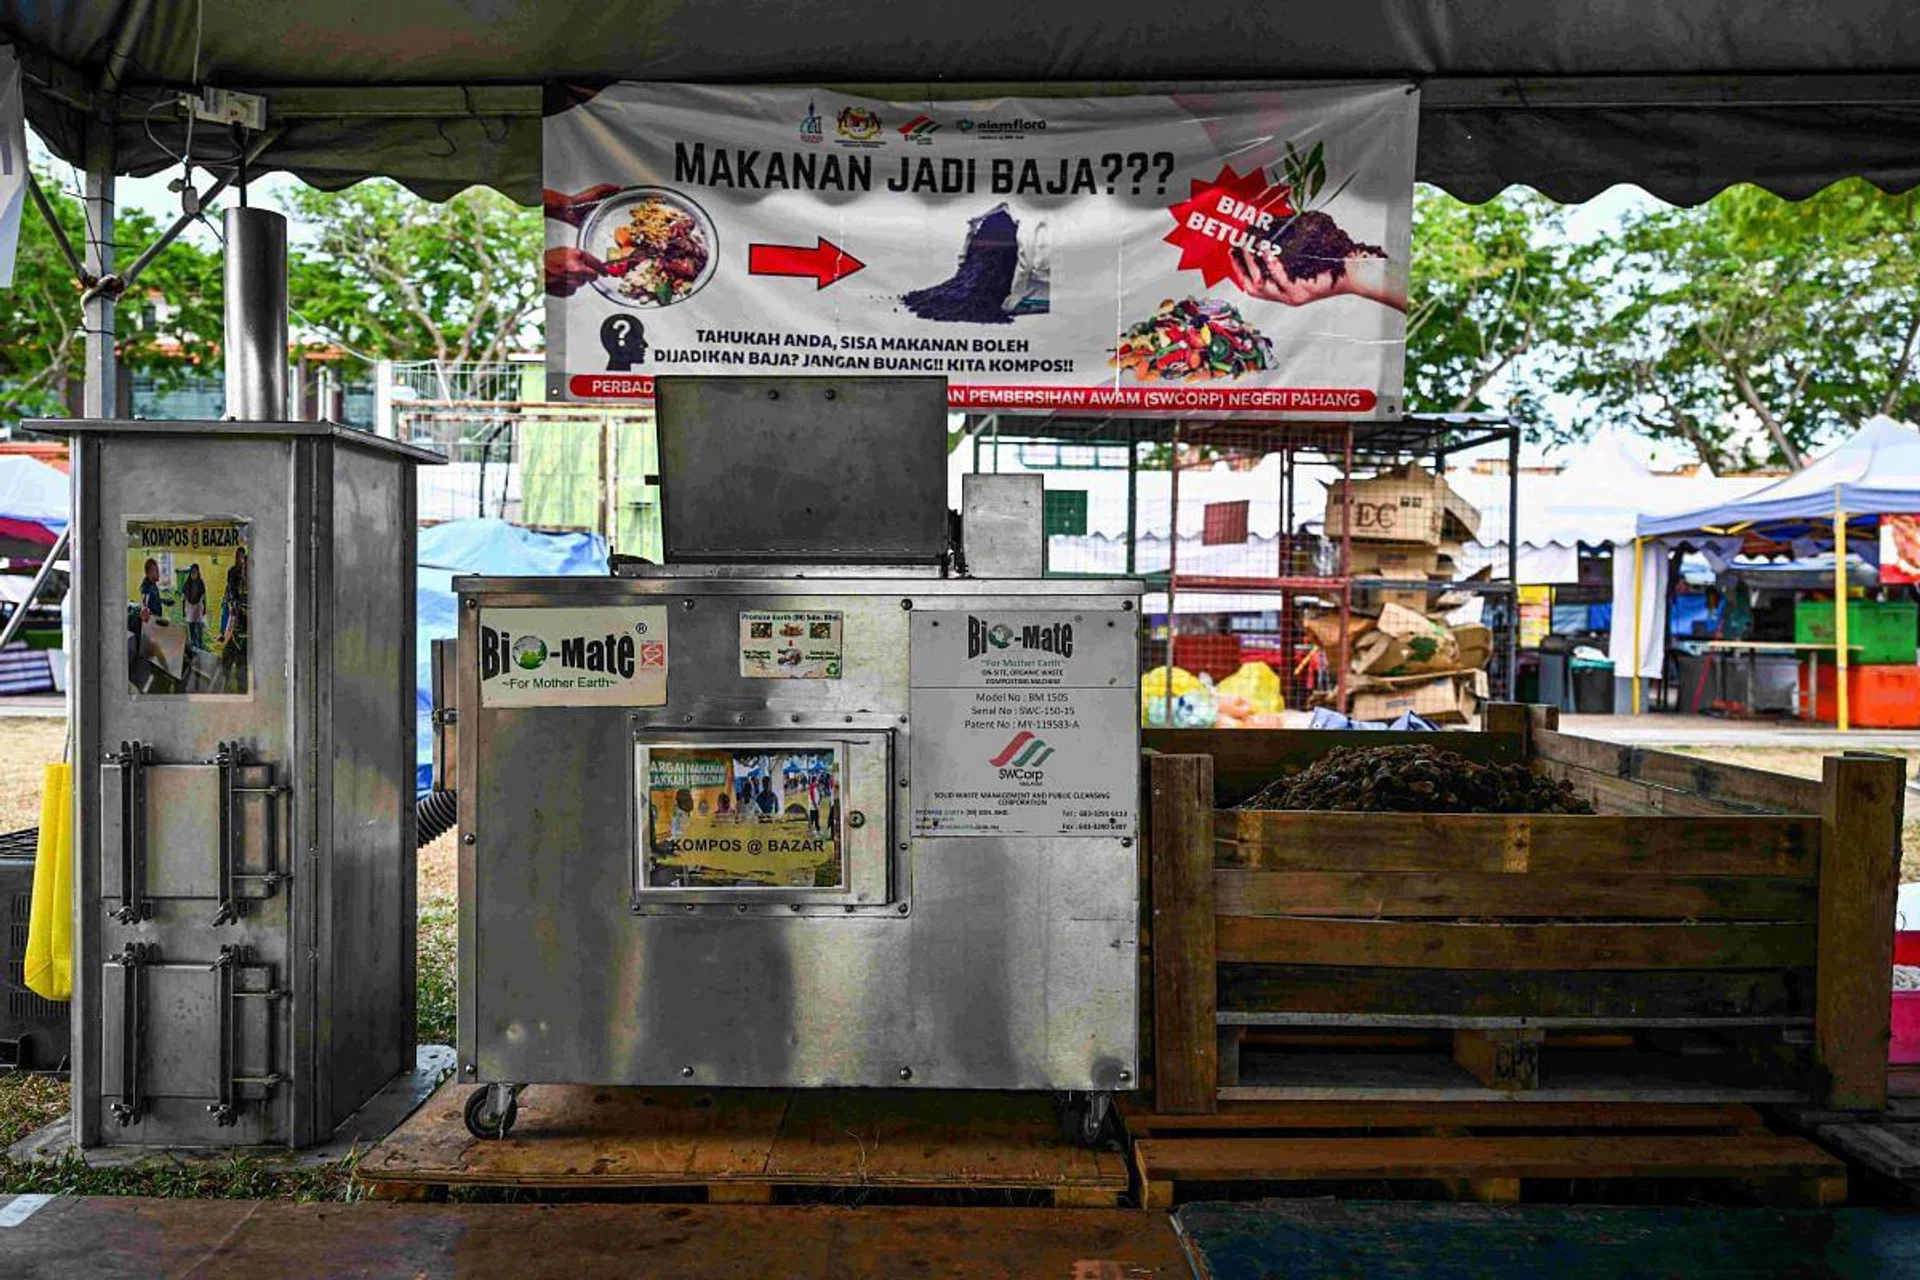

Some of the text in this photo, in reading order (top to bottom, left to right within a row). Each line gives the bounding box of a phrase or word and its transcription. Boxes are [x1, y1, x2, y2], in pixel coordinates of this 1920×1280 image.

[675, 142, 1175, 195] MAKANAN JADI BAJA???
[1216, 195, 1274, 231] BIAR
[696, 329, 1029, 353] TAHUKAH ANDA, SISA MAKANAN BOLEH
[654, 350, 1074, 373] DIJADIKAN BAJA? JANGAN BUANG!! KITA KOMPOS!!
[970, 389, 1085, 405] PEMBERSIHAN
[1090, 390, 1139, 405] AWAM
[1144, 390, 1223, 409] (SWCORP)
[1229, 391, 1286, 407] NEGERI
[1291, 392, 1361, 408] PAHANG
[142, 528, 189, 547] KOMPOS
[202, 528, 240, 547] BAZAR
[533, 677, 573, 688] Mother
[976, 693, 1006, 702] Model
[1008, 693, 1020, 702] No
[1029, 693, 1044, 702] BM
[971, 706, 996, 715] Serial
[999, 706, 1012, 715] No
[965, 720, 995, 729] Patent
[997, 720, 1011, 729] No
[998, 768, 1043, 781] SWCorp
[671, 839, 824, 856] KOMPOS @ BAZAR
